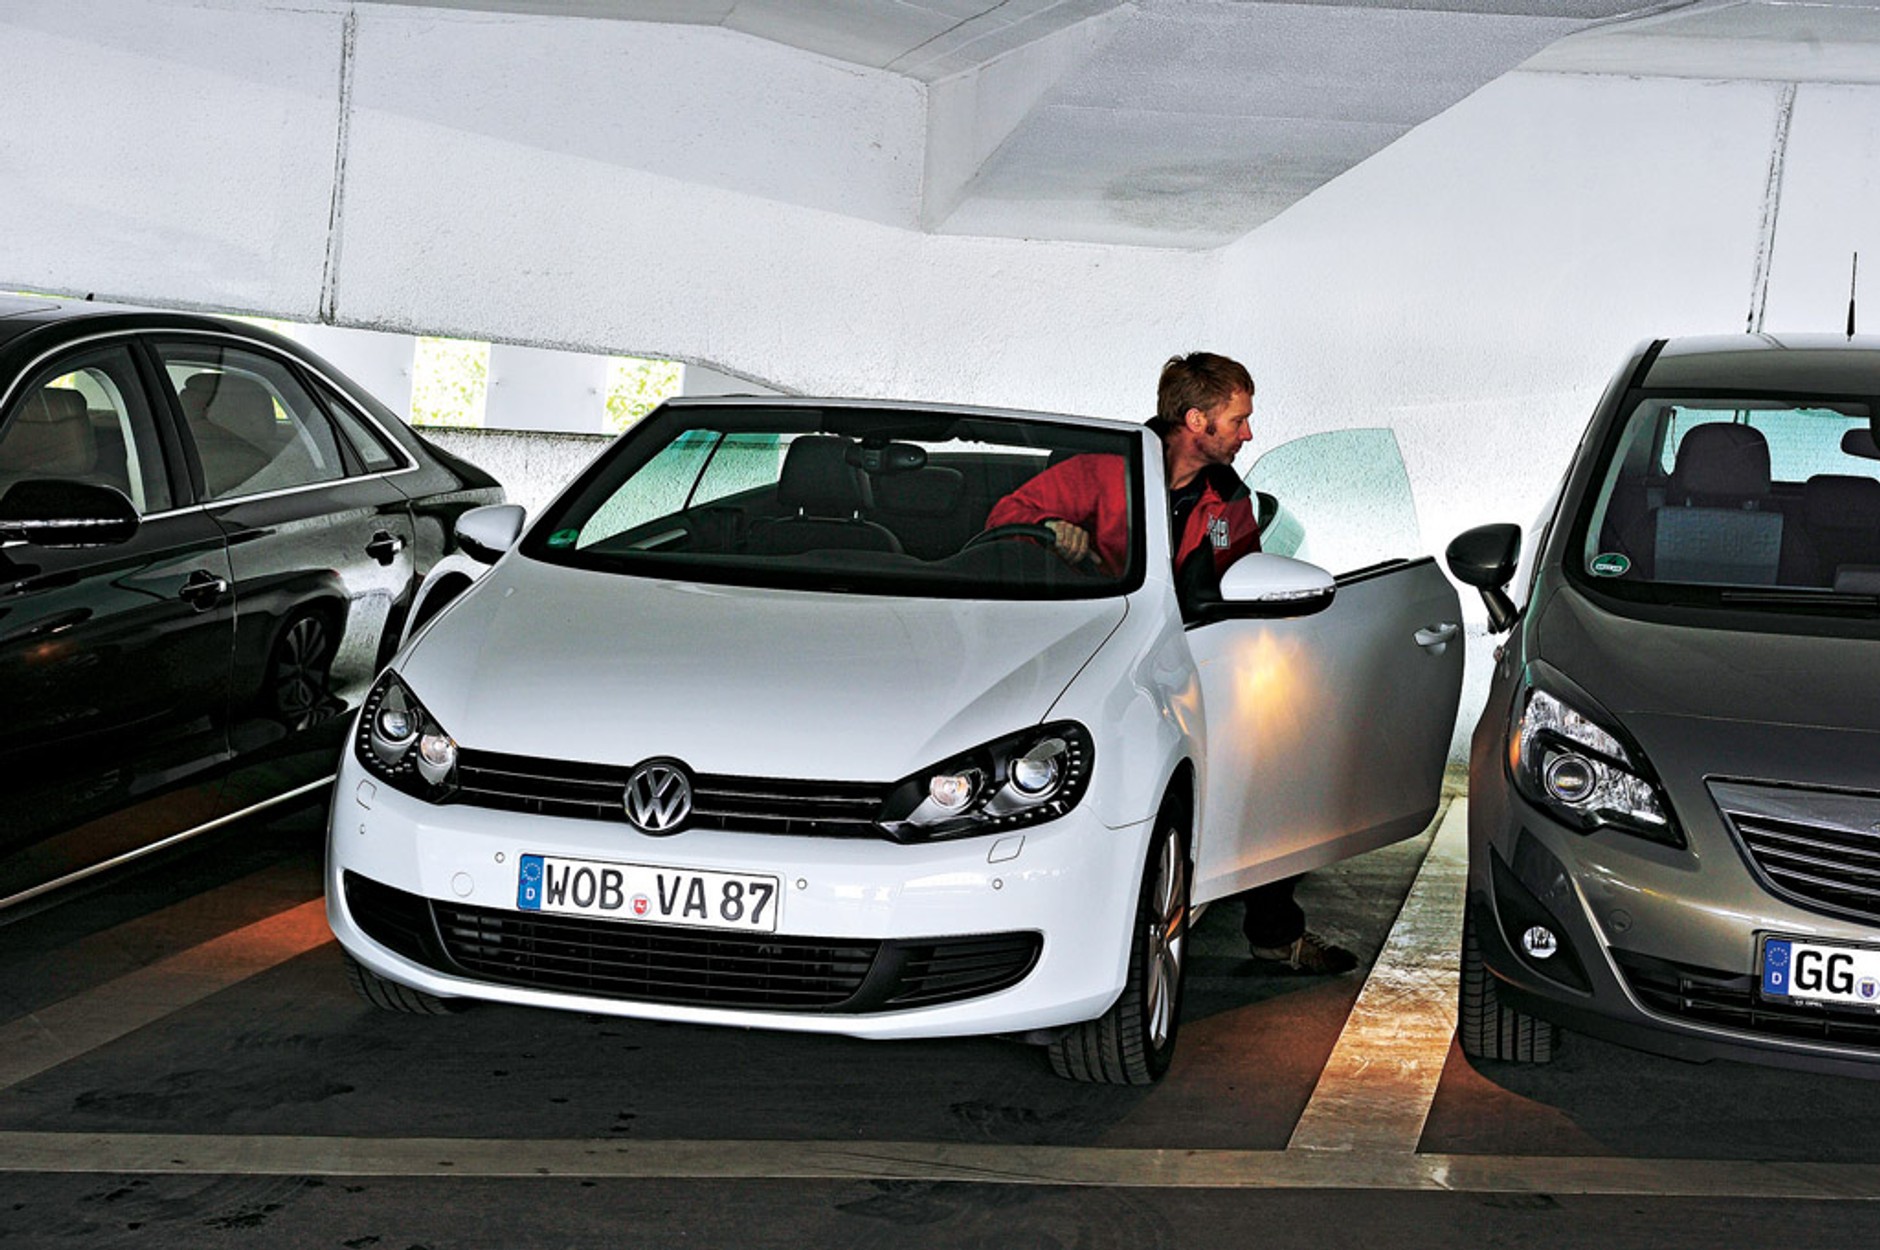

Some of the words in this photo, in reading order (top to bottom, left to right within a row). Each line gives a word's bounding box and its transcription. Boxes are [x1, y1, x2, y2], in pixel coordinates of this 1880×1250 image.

[624, 763, 692, 831] VW
[525, 887, 536, 900] D
[546, 863, 624, 910] WOB
[656, 873, 708, 919] VA
[719, 880, 774, 924] 87
[1771, 971, 1783, 985] D
[1794, 949, 1854, 995] GG
